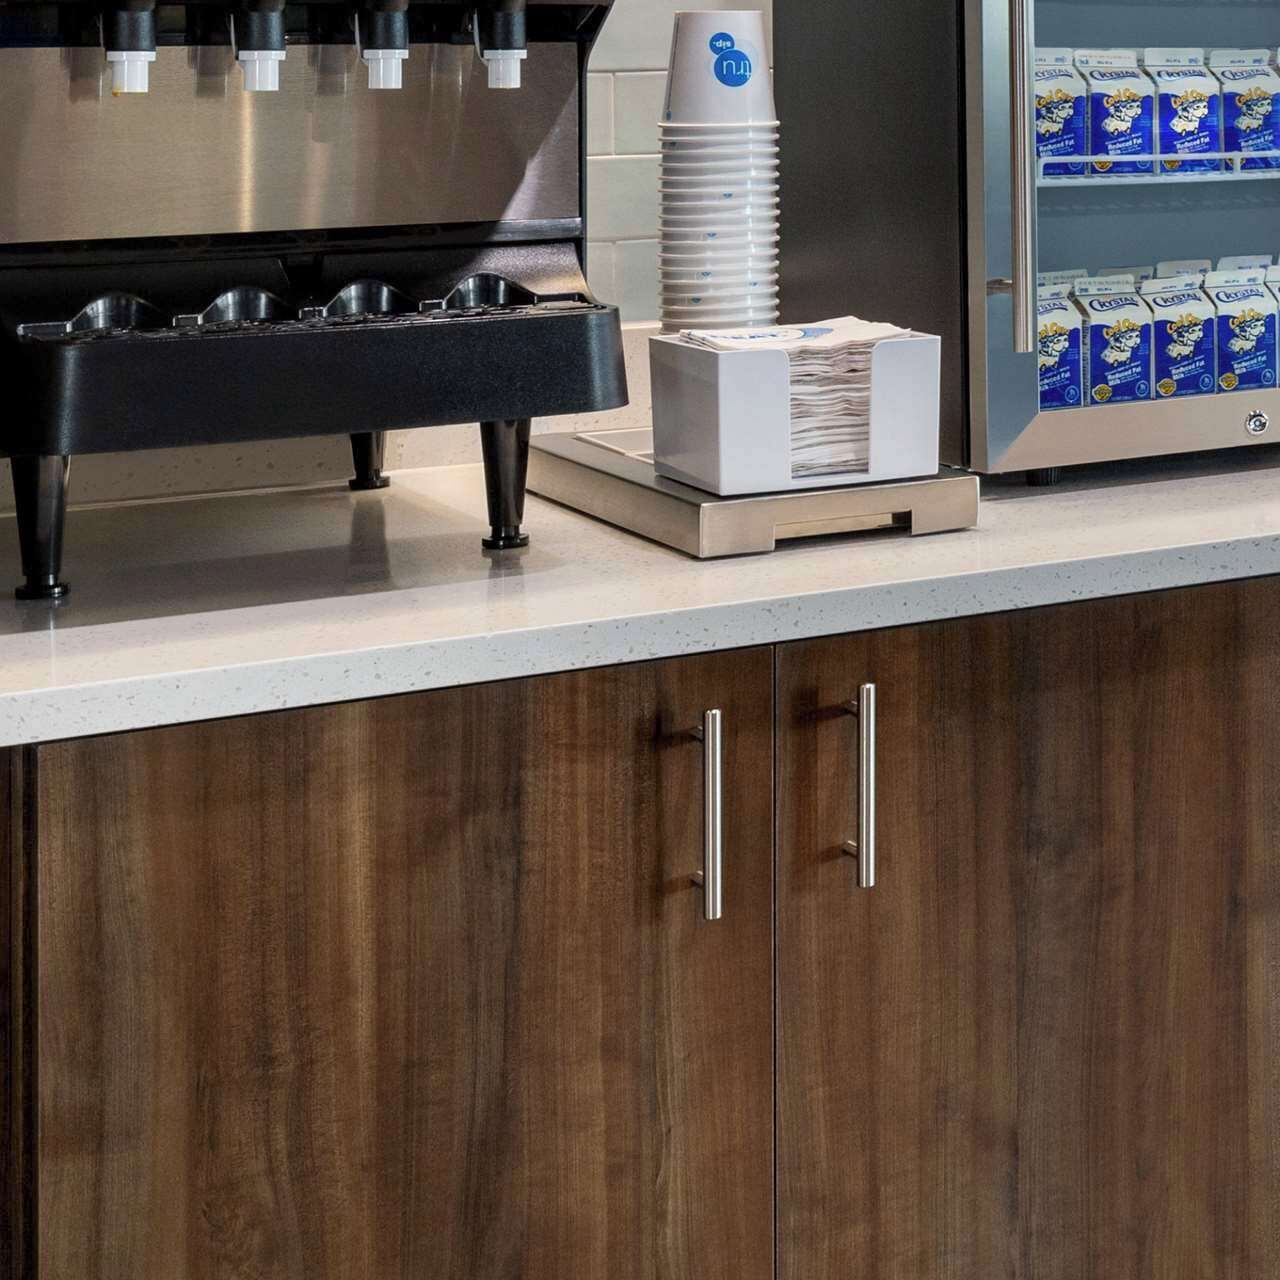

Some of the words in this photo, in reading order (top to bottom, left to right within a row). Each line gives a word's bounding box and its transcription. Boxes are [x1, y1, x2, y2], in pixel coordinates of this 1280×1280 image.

[1035, 69, 1073, 81] RYSTAL
[1153, 292, 1202, 308] CRYSTAL
[1215, 287, 1264, 303] CRYSTAL
[1089, 296, 1139, 312] CRYSTAL
